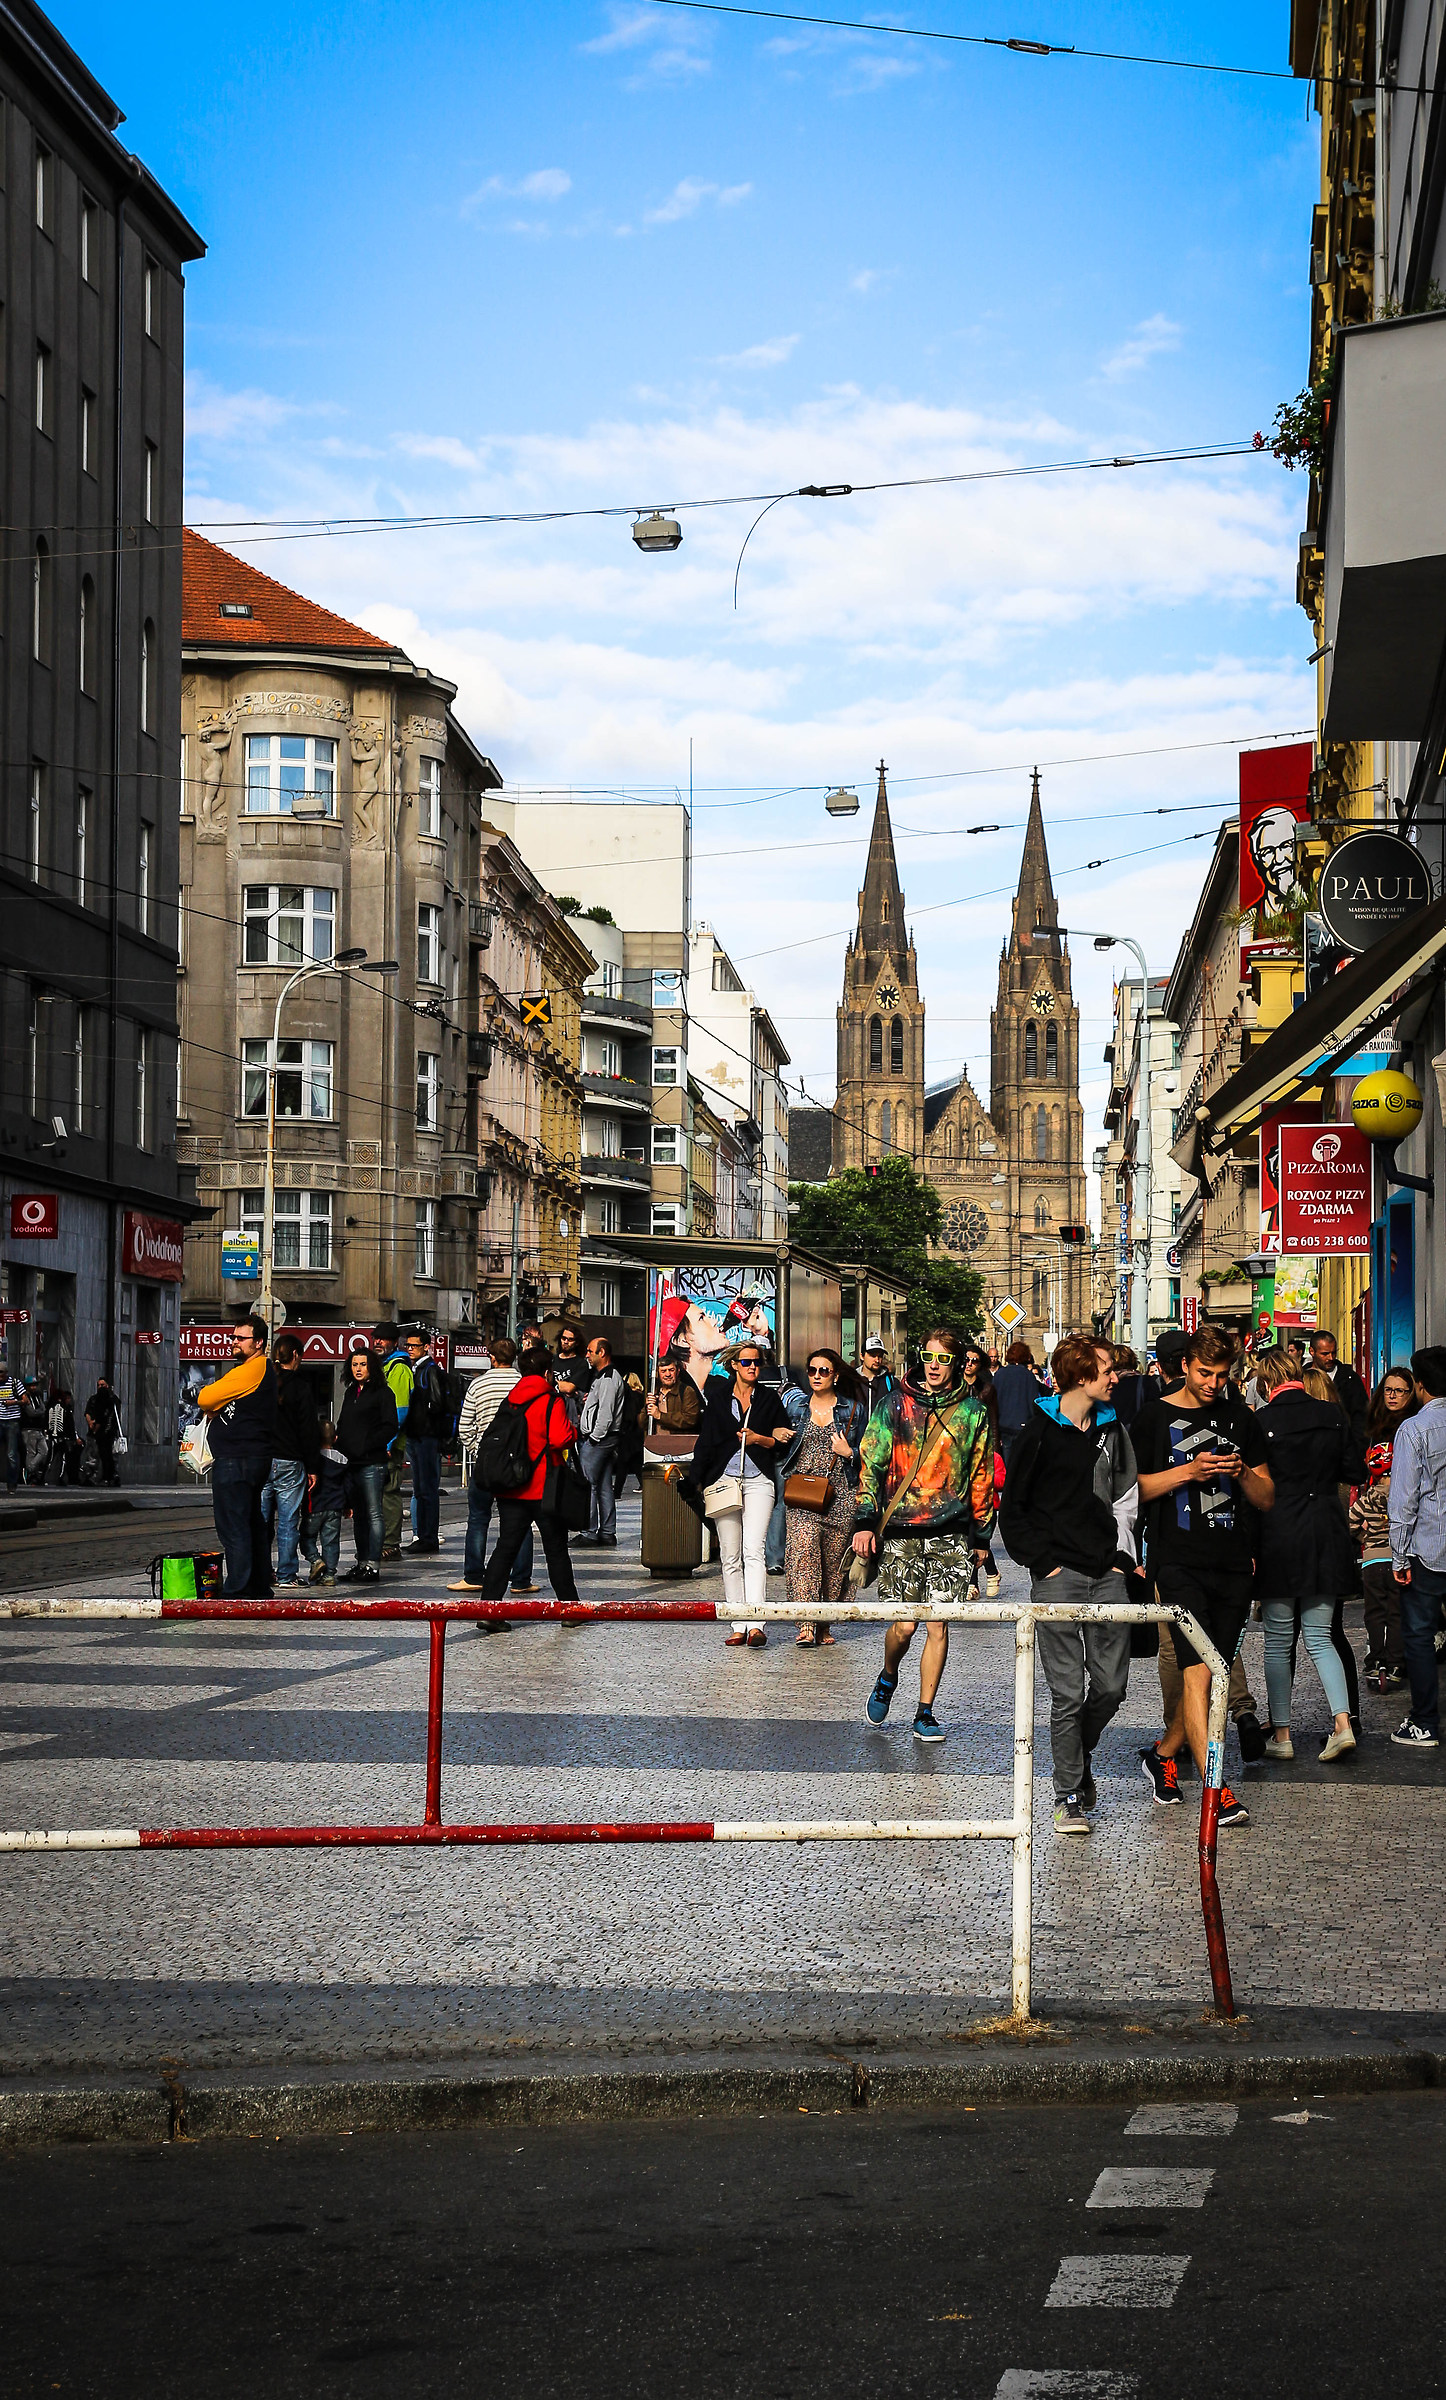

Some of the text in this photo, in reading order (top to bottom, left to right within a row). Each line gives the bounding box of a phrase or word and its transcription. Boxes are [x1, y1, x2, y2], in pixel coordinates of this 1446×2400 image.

[1330, 876, 1425, 900] PAUL
[1318, 931, 1341, 947] M
[1287, 1190, 1366, 1201] ROZVOZ PIZZY
[1299, 1203, 1354, 1216] ZDARMA
[13, 1225, 53, 1233] vodafone
[228, 1238, 253, 1246] albert
[1265, 1235, 1280, 1252] K
[1300, 1235, 1368, 1246] 605 238 600
[146, 1234, 182, 1263] vodafone
[179, 1329, 232, 1345] NÍ TECH
[187, 1346, 232, 1357] PŘÍSLUŠ
[436, 1336, 445, 1371] CHA
[455, 1345, 489, 1354] EXCHANG
